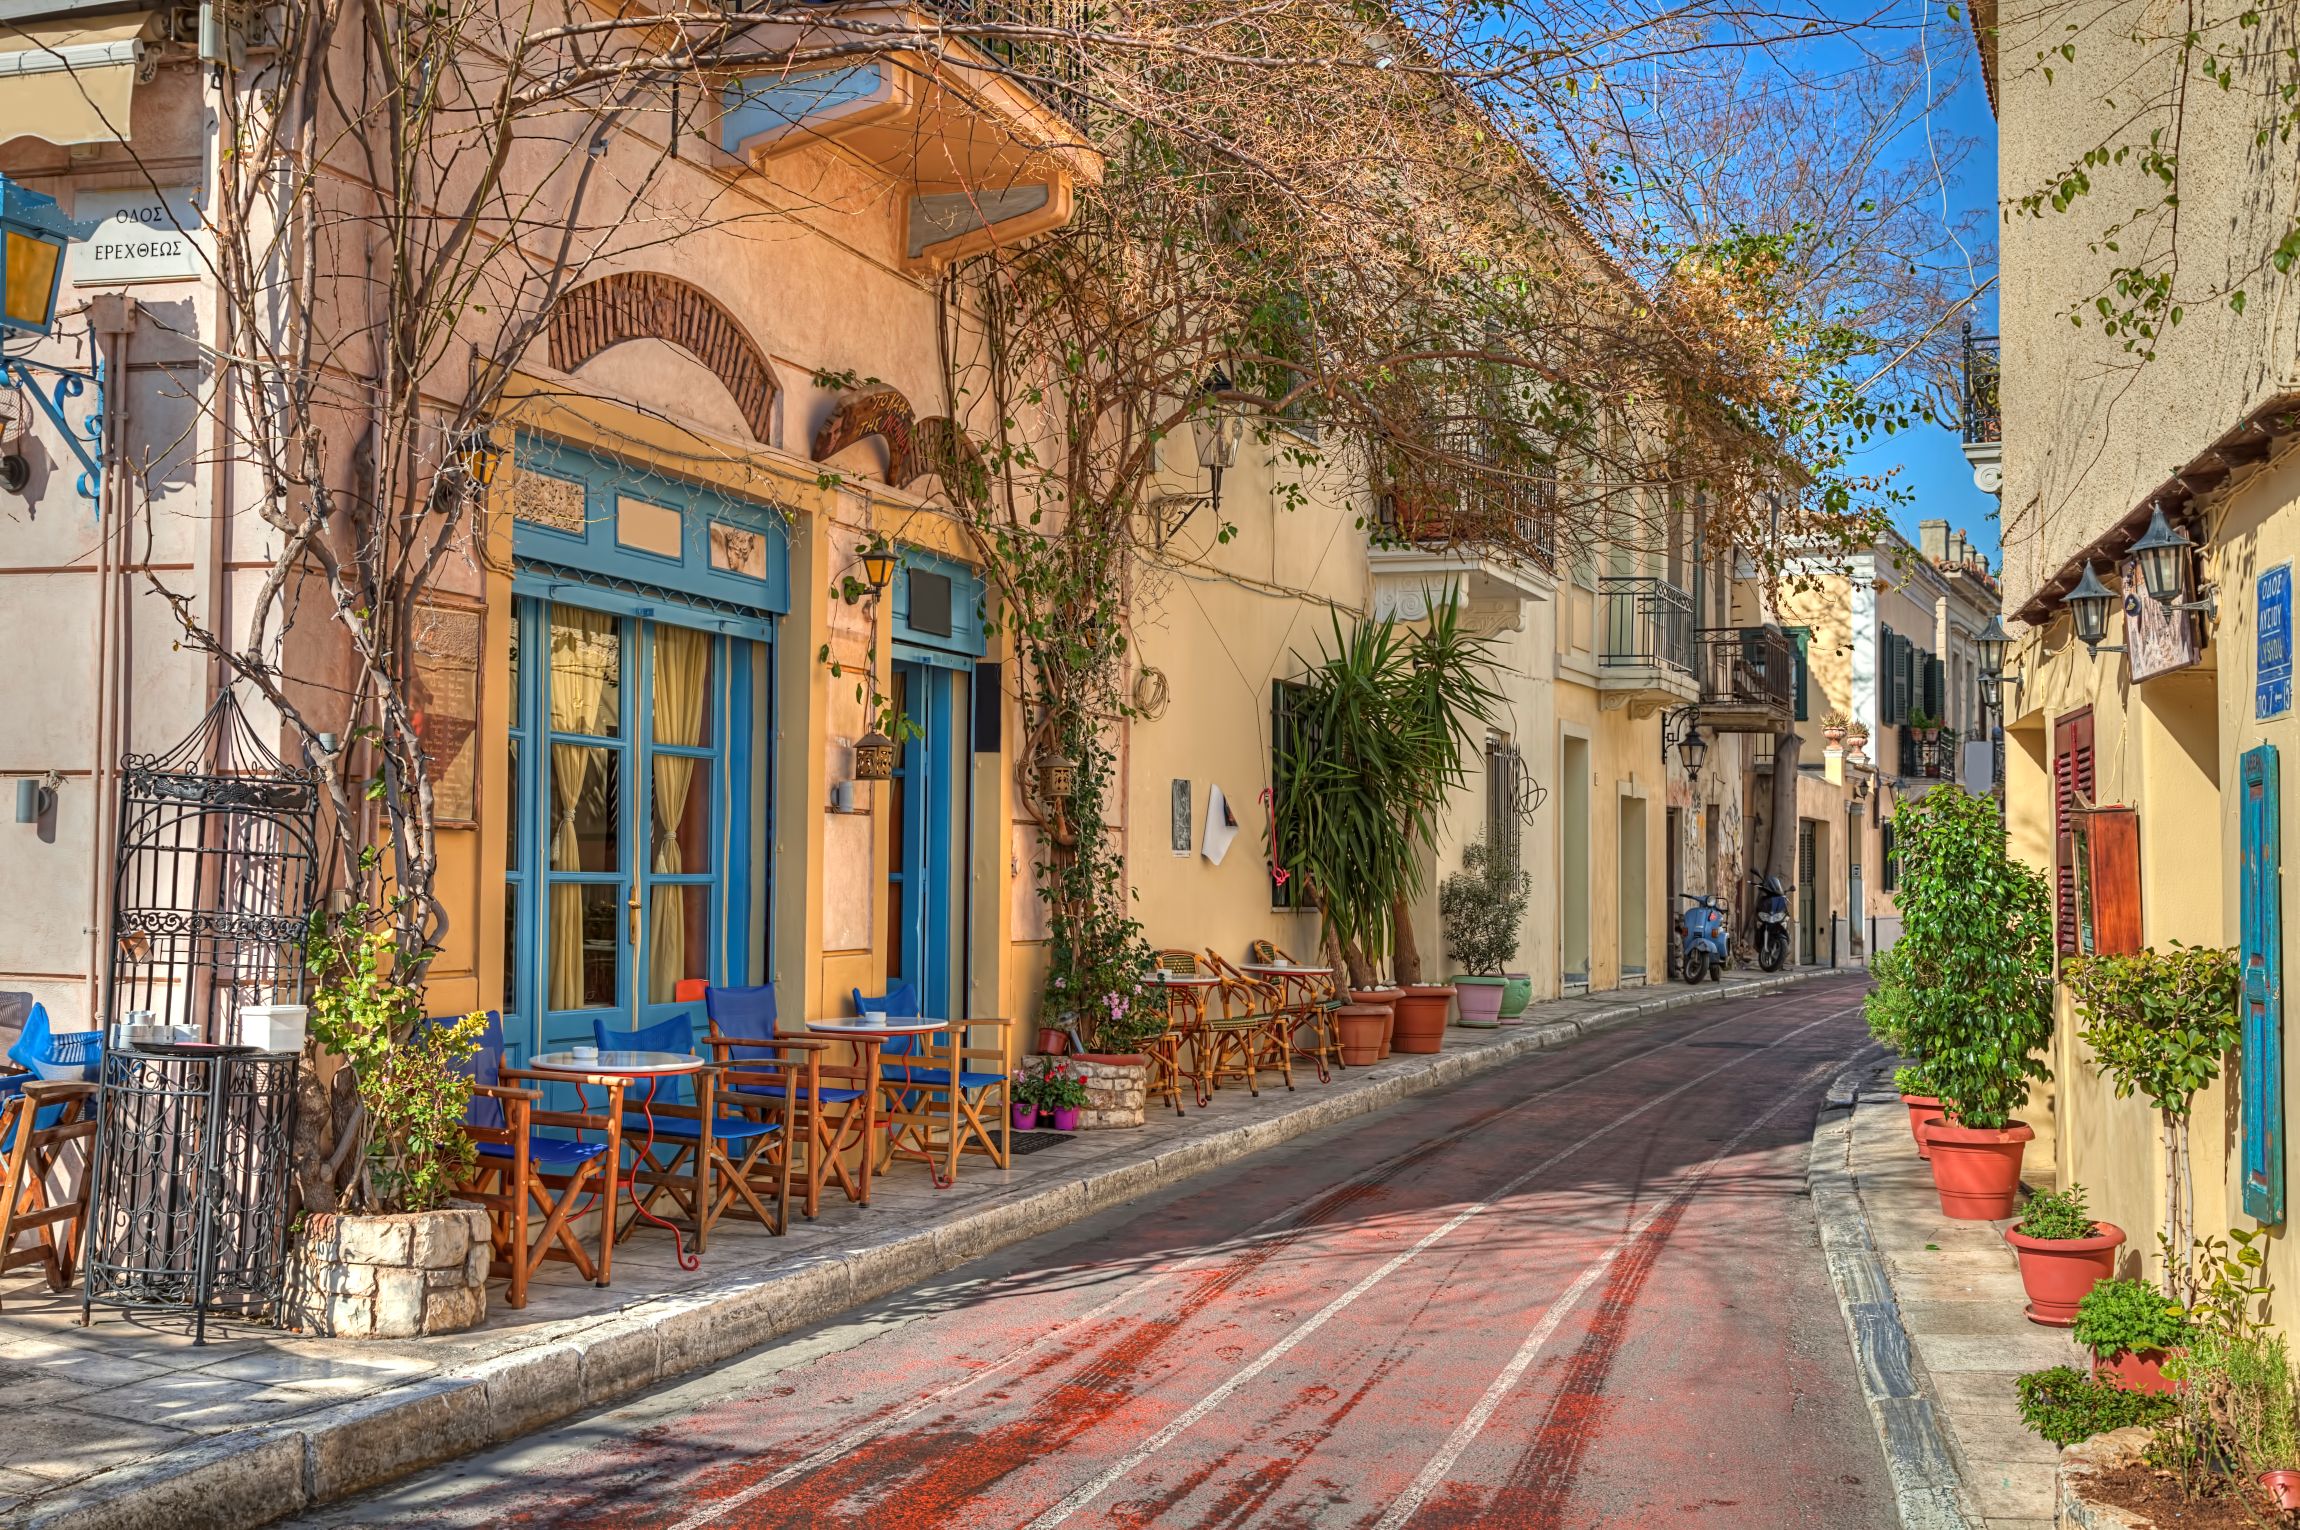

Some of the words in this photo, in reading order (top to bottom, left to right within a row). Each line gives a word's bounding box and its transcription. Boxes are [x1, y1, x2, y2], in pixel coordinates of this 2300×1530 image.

[116, 206, 163, 223] ΟΔΟΣ
[95, 241, 182, 260] ΕΡΕΧΘΕΩΣ
[2262, 574, 2282, 600] ΟΔΟΣ
